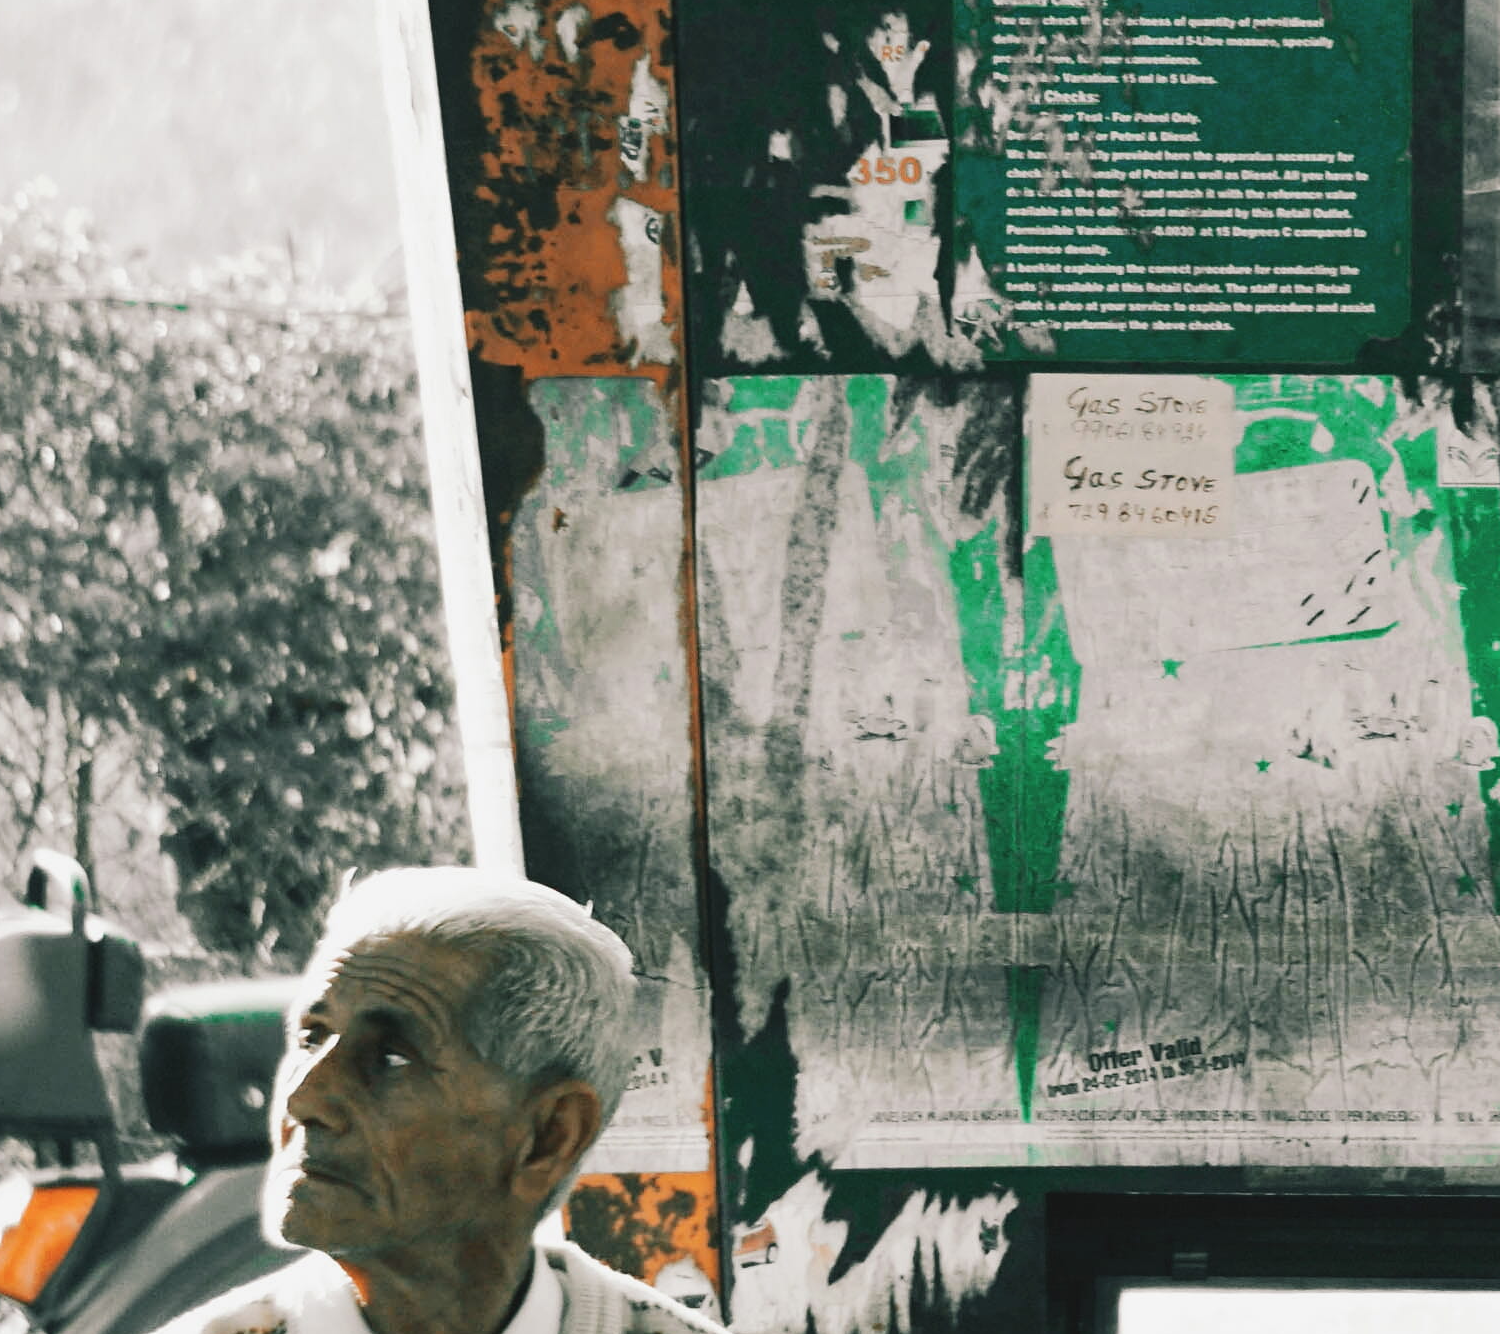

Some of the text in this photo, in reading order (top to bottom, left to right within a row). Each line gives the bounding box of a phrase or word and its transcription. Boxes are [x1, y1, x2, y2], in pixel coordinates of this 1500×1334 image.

[852, 156, 922, 186] 350
[1066, 386, 1121, 418] Gas
[1063, 455, 1220, 493] Gas STOVE
[1089, 1036, 1202, 1072] Offer Valid
